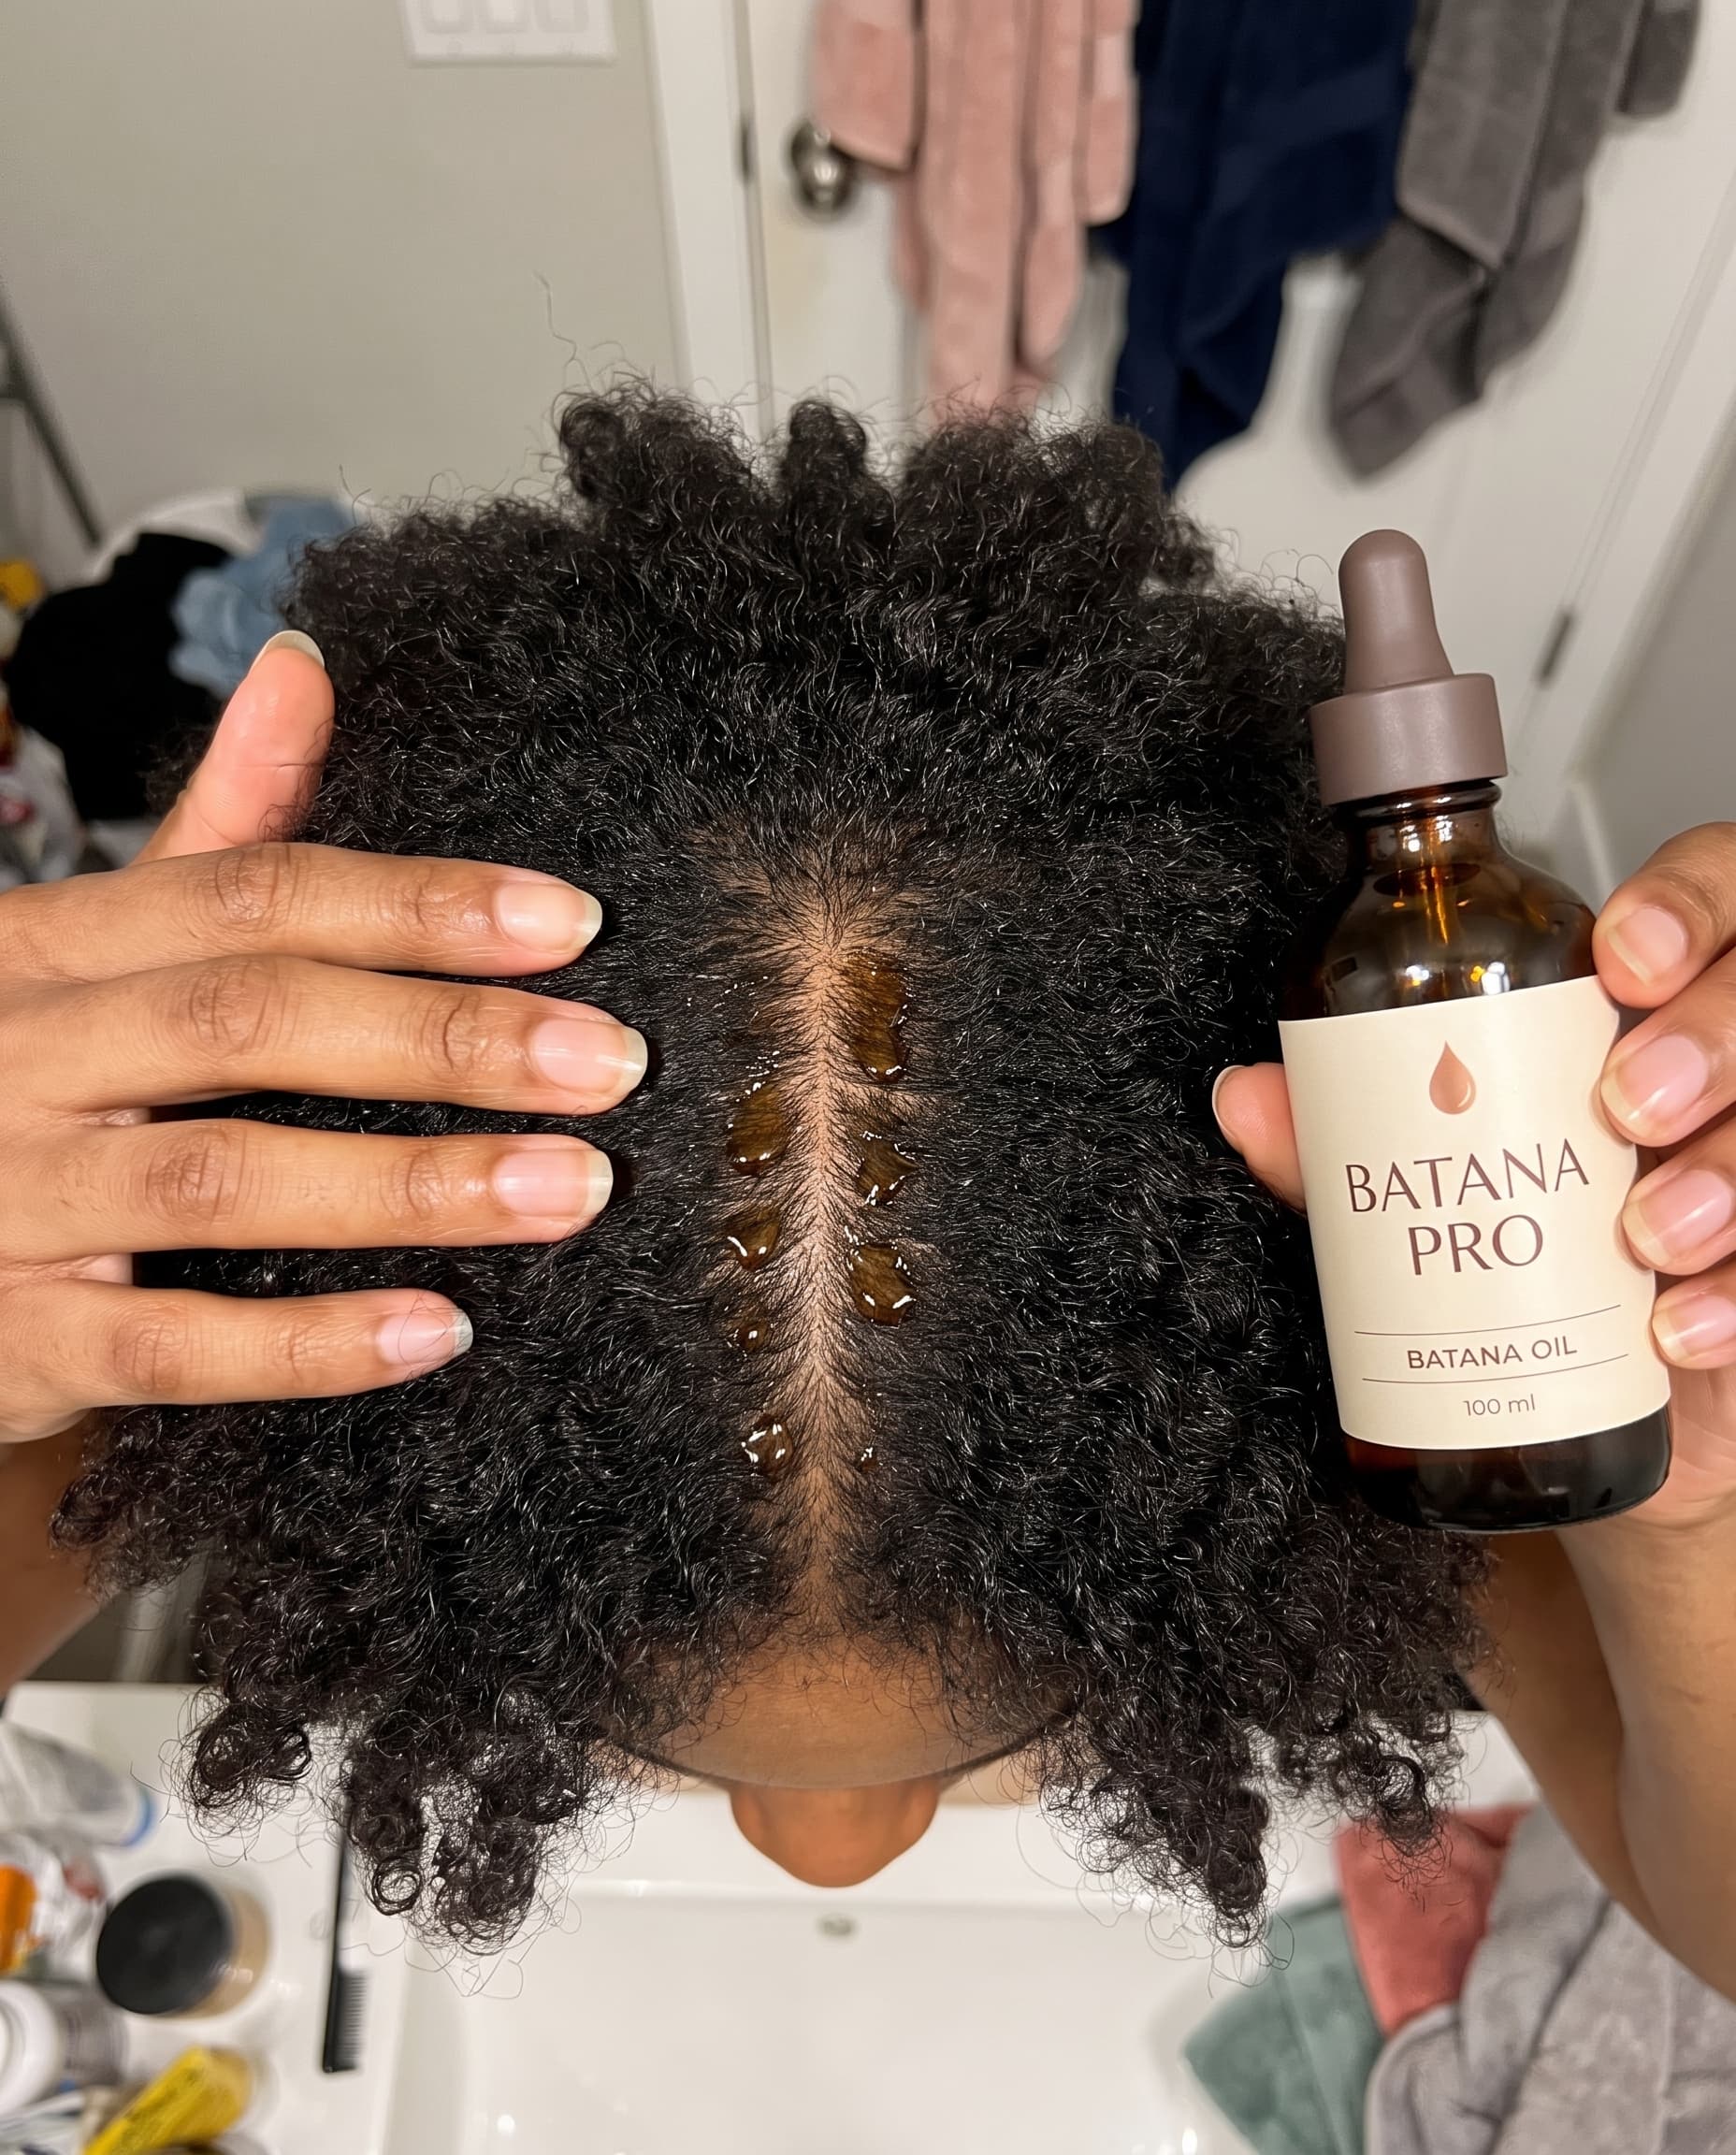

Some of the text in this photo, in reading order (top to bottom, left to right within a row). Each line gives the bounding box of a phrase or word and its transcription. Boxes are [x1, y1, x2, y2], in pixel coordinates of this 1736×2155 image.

[1345, 1138, 1590, 1213] BATANA
[1407, 1214, 1543, 1276] PRO
[1407, 1336, 1577, 1369] BATANA OIL
[1463, 1394, 1536, 1416] 100 ml
